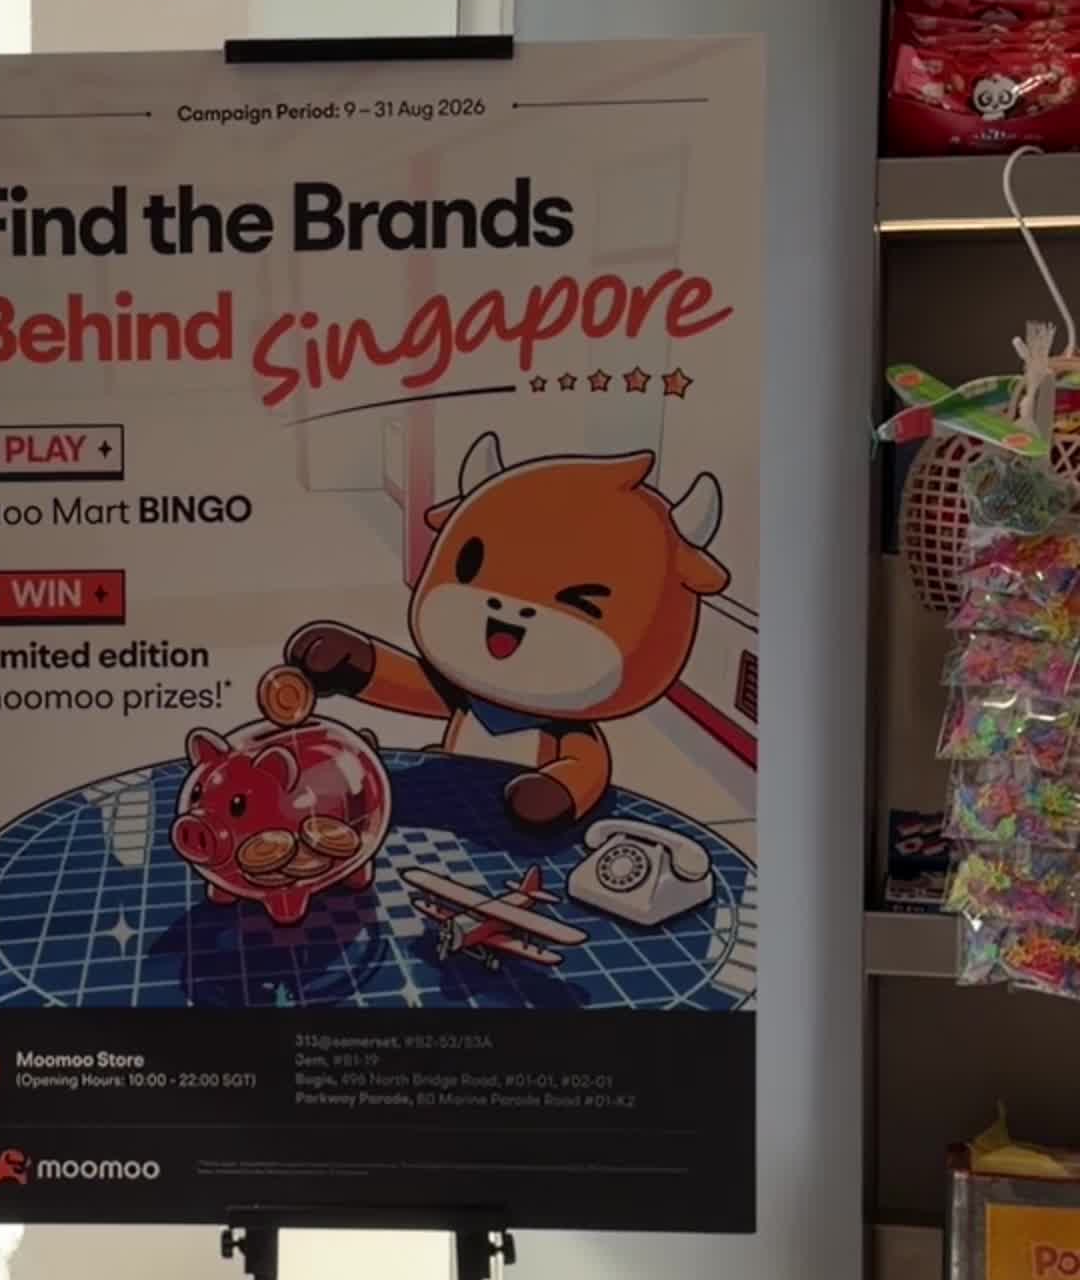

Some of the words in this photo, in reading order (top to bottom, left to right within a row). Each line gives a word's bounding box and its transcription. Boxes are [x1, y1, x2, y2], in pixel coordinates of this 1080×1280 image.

[177, 104, 271, 125] Campaign
[276, 102, 340, 120] Period:
[343, 100, 357, 118] 9
[374, 100, 394, 118] 31
[398, 99, 434, 121] Aug
[438, 98, 486, 117] 2026
[143, 184, 273, 255] the
[292, 177, 574, 252] Brands
[252, 268, 734, 407] Singapore
[4, 434, 87, 464] PLAY
[52, 496, 131, 525] Mart
[138, 494, 253, 524] BINGO
[10, 579, 82, 609] WIN
[98, 639, 209, 668] edition
[16, 1051, 95, 1068] Moomoo
[96, 1050, 145, 1068] Store
[16, 1072, 79, 1091] (Opening
[81, 1072, 124, 1087] Hours:
[128, 1072, 167, 1087] 10:00
[179, 1072, 219, 1087] 22:00
[221, 1072, 257, 1089] SGT)
[37, 1159, 161, 1180] moomoo
